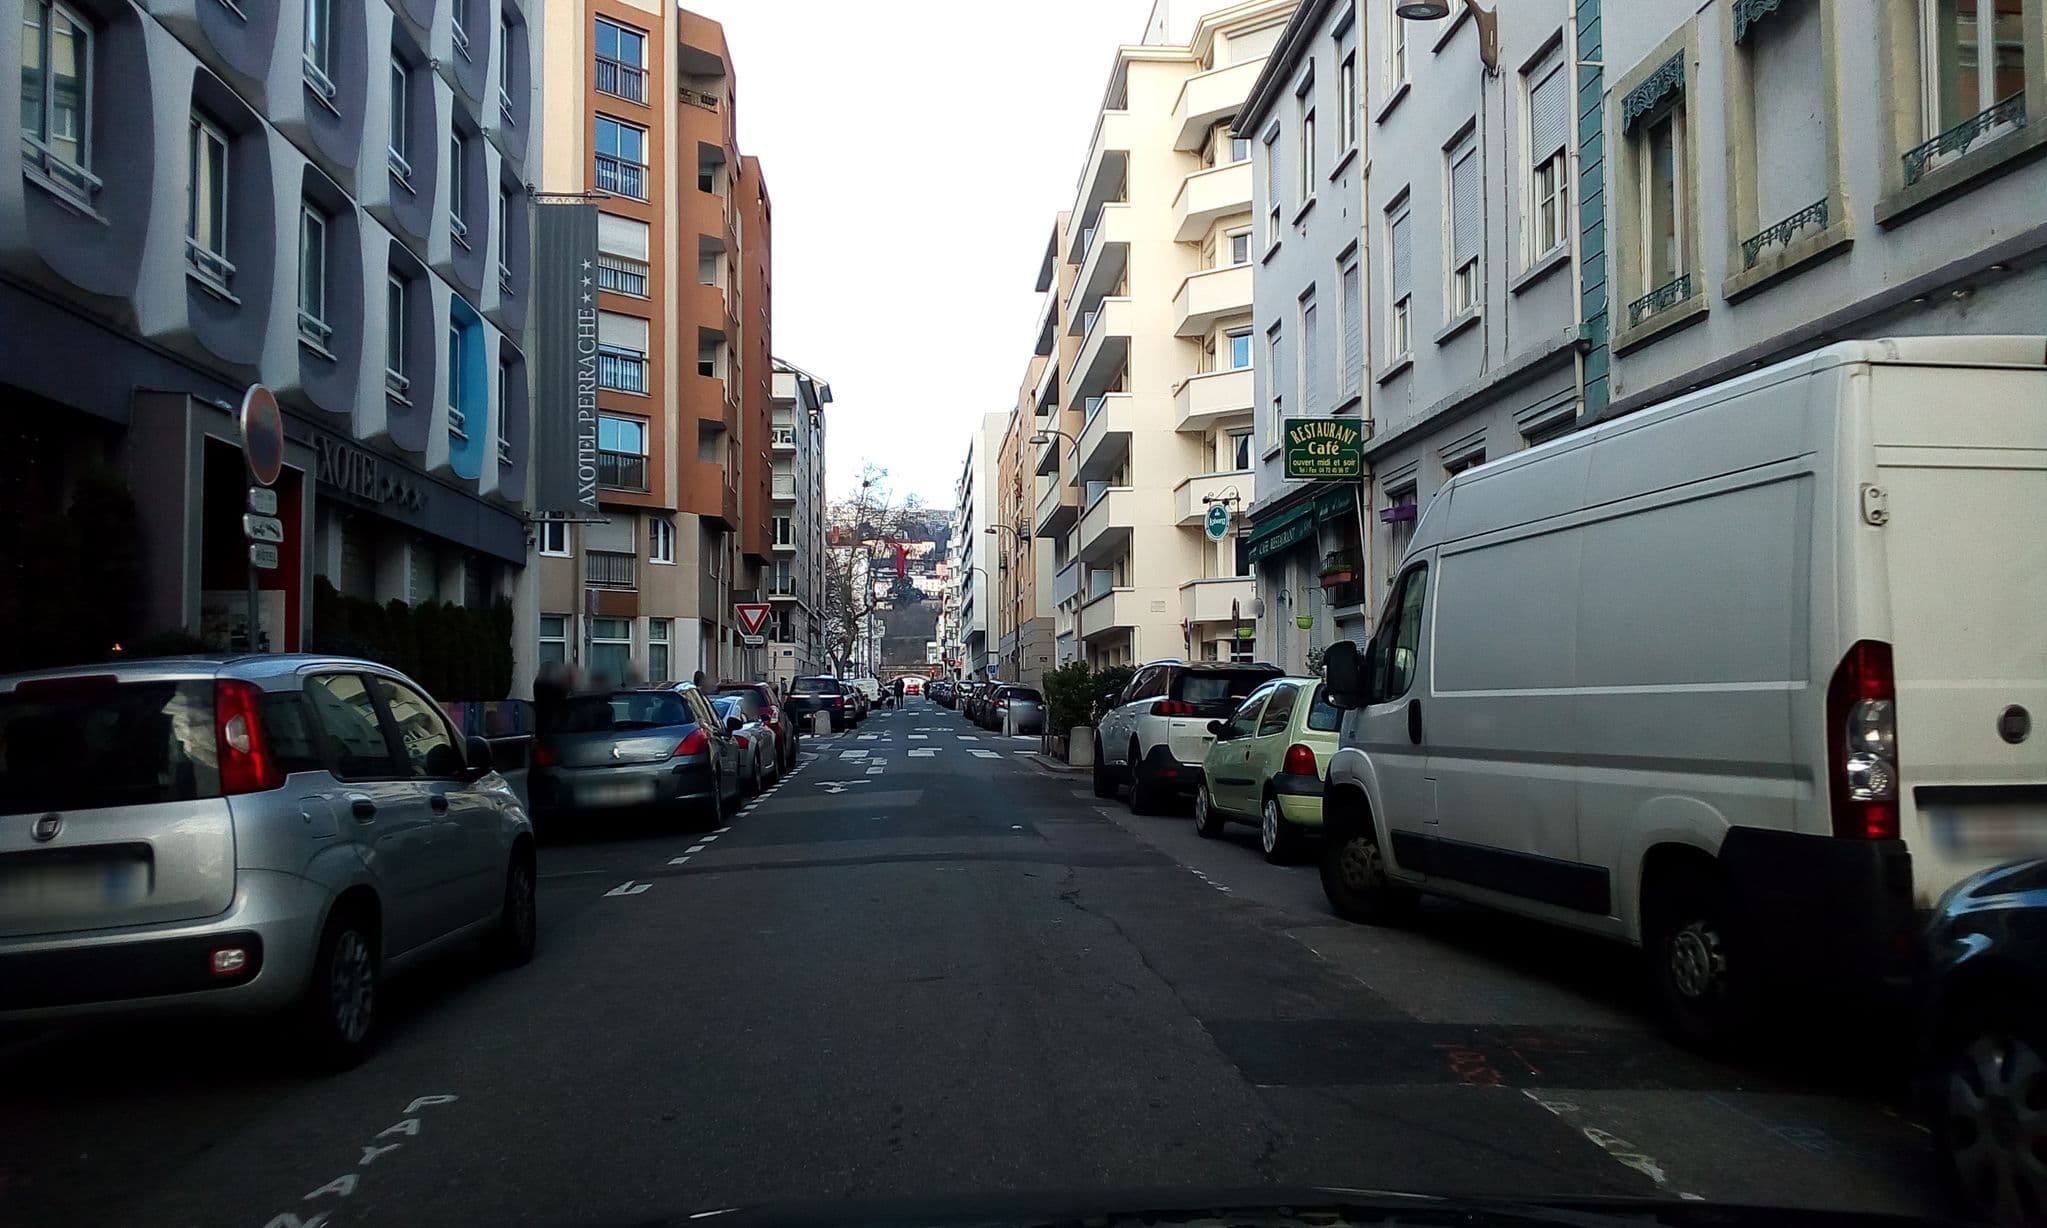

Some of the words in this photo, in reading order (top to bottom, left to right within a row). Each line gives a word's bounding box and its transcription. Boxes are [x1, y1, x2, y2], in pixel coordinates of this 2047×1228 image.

[578, 307, 596, 423] PERRACHE
[1290, 422, 1358, 445] RESTAURANT
[1308, 441, 1339, 455] Café
[315, 434, 385, 504] XOTEL
[578, 427, 596, 509] AXOTEL
[1292, 459, 1314, 467] ouvert
[1317, 458, 1331, 466] midi
[1343, 458, 1356, 466] soir
